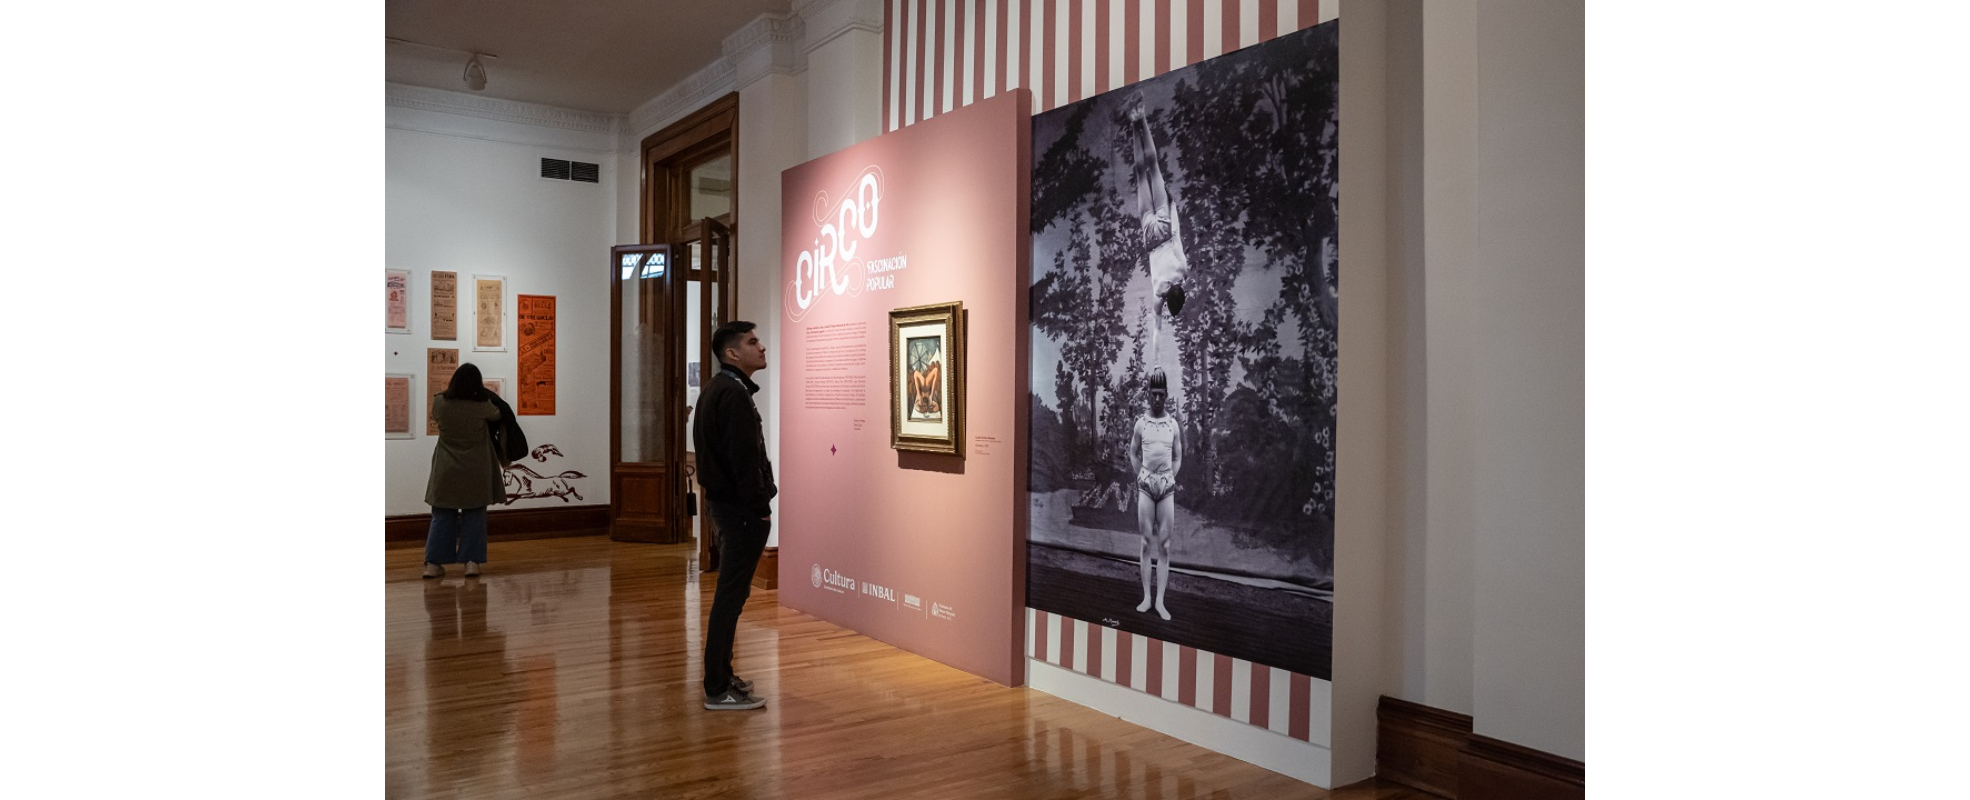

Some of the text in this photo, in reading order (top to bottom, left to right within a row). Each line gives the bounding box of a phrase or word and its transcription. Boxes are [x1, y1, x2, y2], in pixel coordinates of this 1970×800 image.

[866, 251, 907, 274] FASCINACIÓN
[866, 274, 895, 291] POPULAR
[823, 568, 856, 590] Cultura
[869, 583, 895, 602] INBAL
